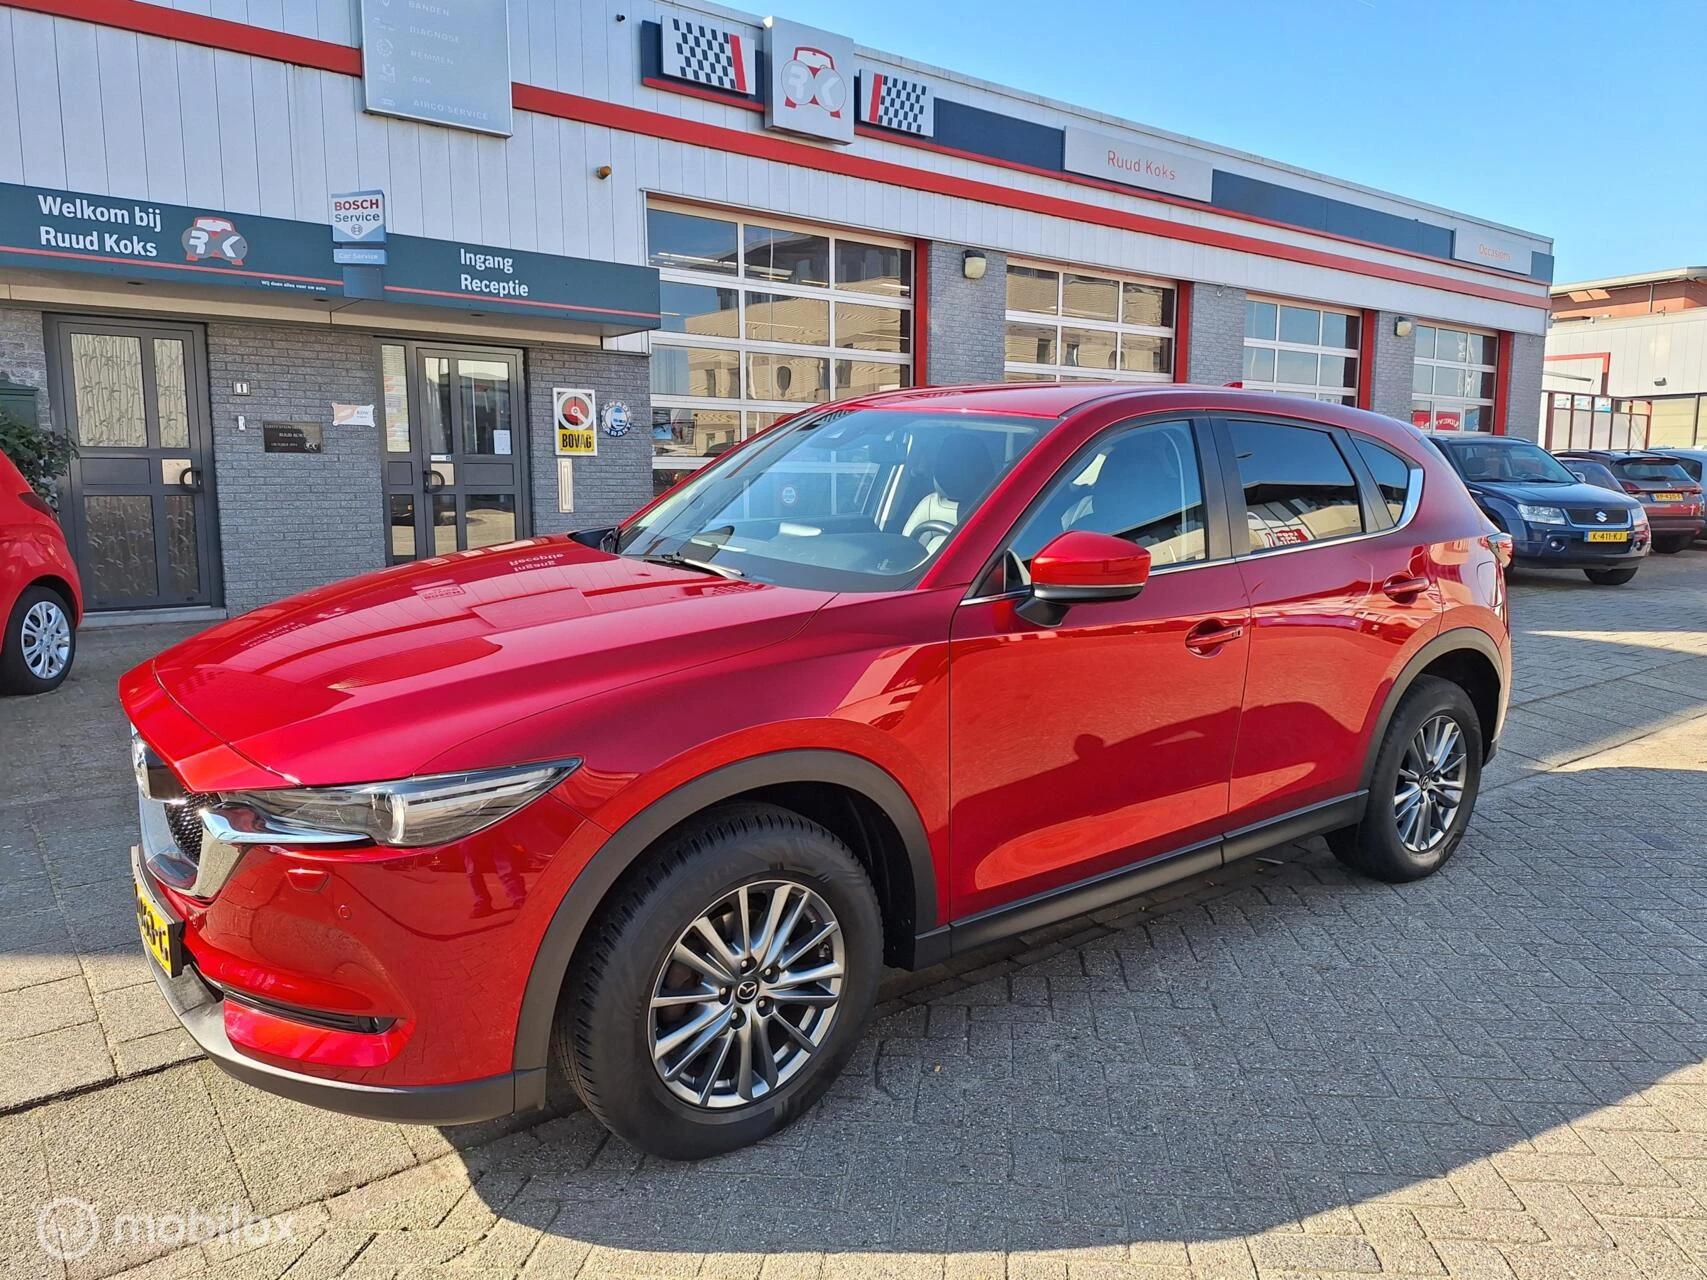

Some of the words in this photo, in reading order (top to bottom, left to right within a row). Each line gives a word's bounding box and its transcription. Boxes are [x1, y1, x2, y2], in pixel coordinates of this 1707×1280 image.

[1107, 150, 1141, 173] Ruud
[1145, 159, 1177, 181] Koks
[38, 194, 130, 225] Welkom
[135, 206, 162, 233] bij
[334, 198, 379, 211] BOSCH
[334, 212, 380, 223] Service
[40, 225, 99, 251] Ruud
[104, 233, 158, 258] Koks
[460, 248, 513, 275] Ingang
[460, 274, 529, 298] Receptie
[561, 433, 592, 449] BOVAG
[1592, 532, 1623, 541] K-411-KJ
